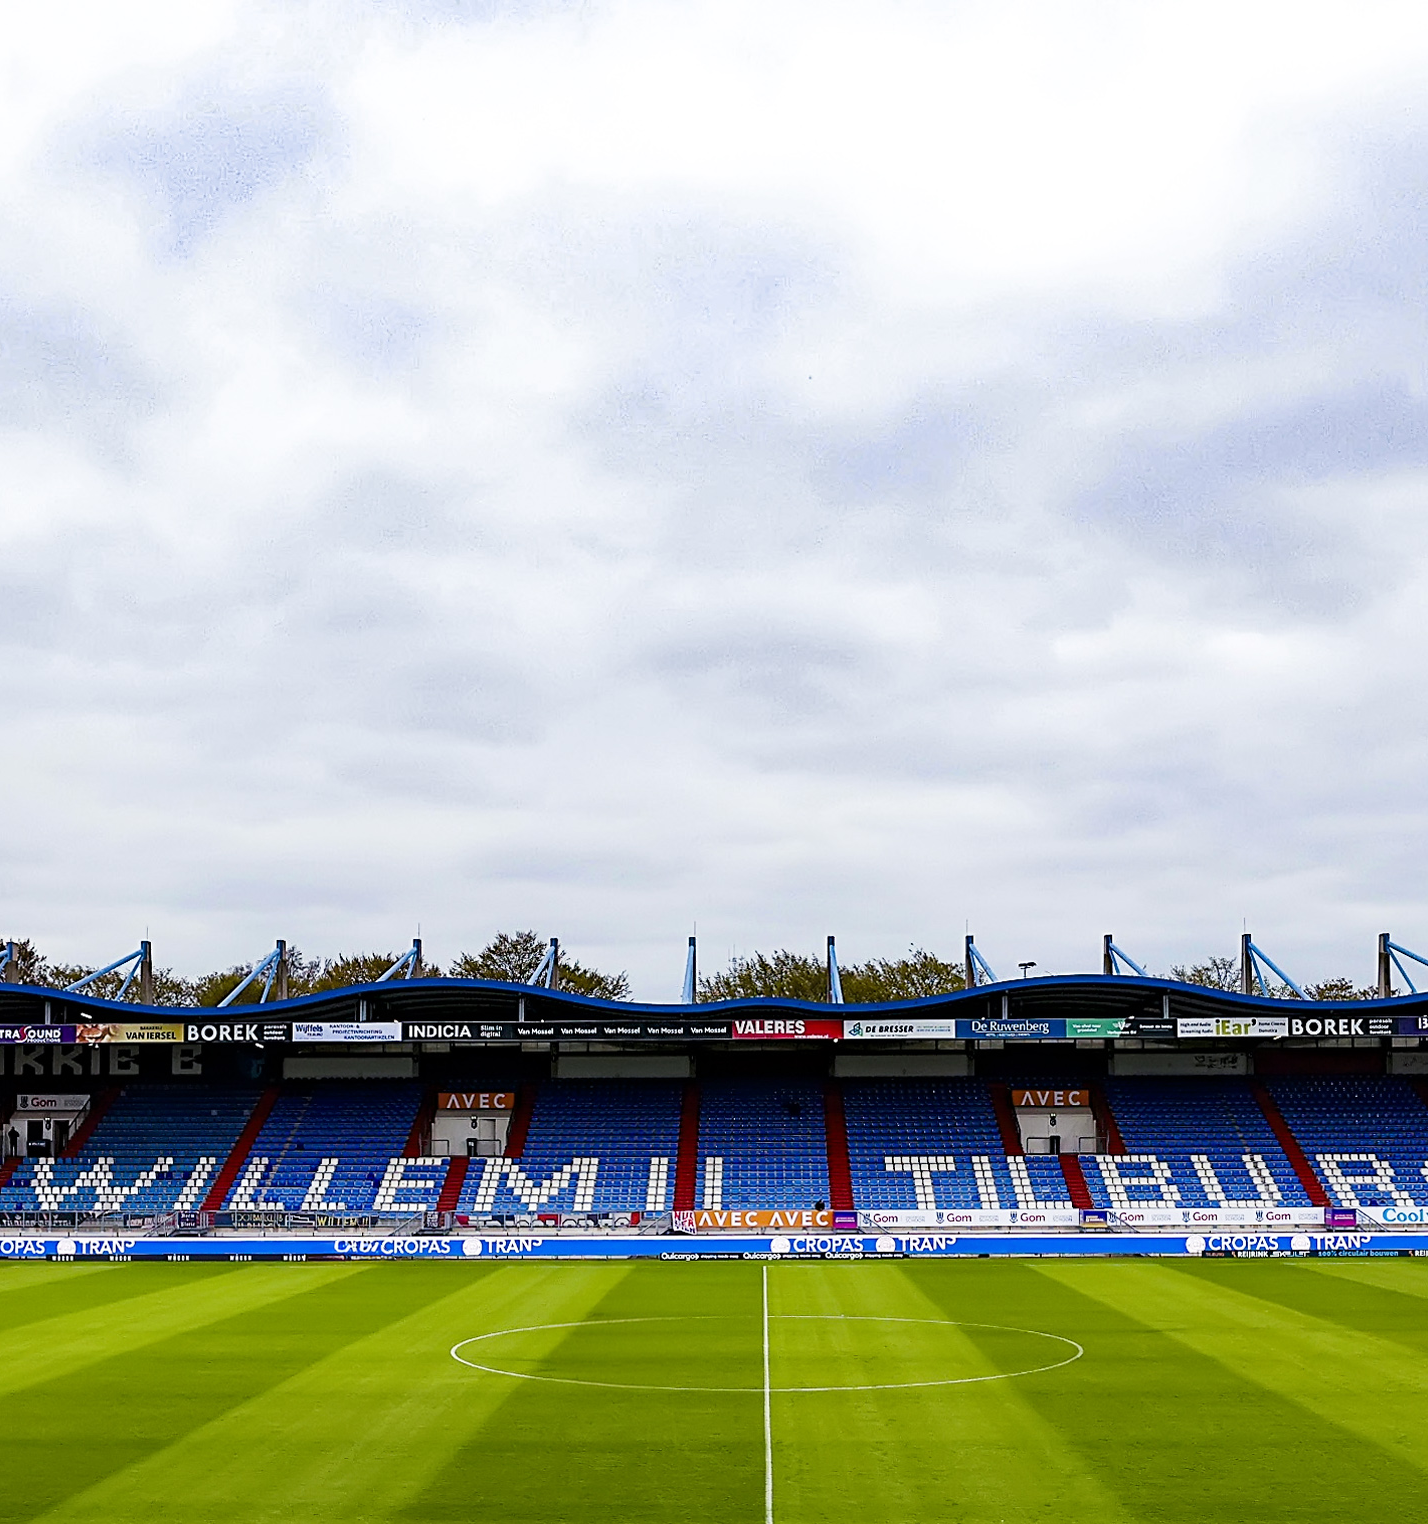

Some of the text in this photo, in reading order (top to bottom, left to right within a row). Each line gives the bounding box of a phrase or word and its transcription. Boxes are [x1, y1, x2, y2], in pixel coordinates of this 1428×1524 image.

[187, 1024, 259, 1041] BOREK
[408, 1024, 472, 1038] INDICIA
[690, 1026, 727, 1034] Van Mossel
[735, 1020, 806, 1034] VALERES
[865, 1025, 914, 1033] DE BRESSER
[972, 1020, 1050, 1034] De Ruwenberg
[1292, 1018, 1364, 1036] BOREK
[125, 1031, 177, 1041] VAN IERSEL
[31, 1098, 57, 1108] Gom
[447, 1094, 506, 1109] AVEC
[1021, 1090, 1081, 1106] AVEC
[699, 1212, 757, 1226] AVEC
[769, 1212, 829, 1226] AVEC
[873, 1213, 898, 1223] Gom
[947, 1213, 972, 1222] Gom
[1020, 1212, 1045, 1222] Gom
[1119, 1212, 1145, 1222] Gom
[1193, 1211, 1218, 1222] Gom
[1265, 1211, 1291, 1221] Gom
[381, 1240, 451, 1254] CROPAS
[793, 1238, 863, 1252] CROPAS
[1208, 1236, 1279, 1251] CROPAS
[661, 1252, 695, 1260] Quicargo
[743, 1252, 777, 1260] Quicargo
[825, 1252, 859, 1260] Quicargo
